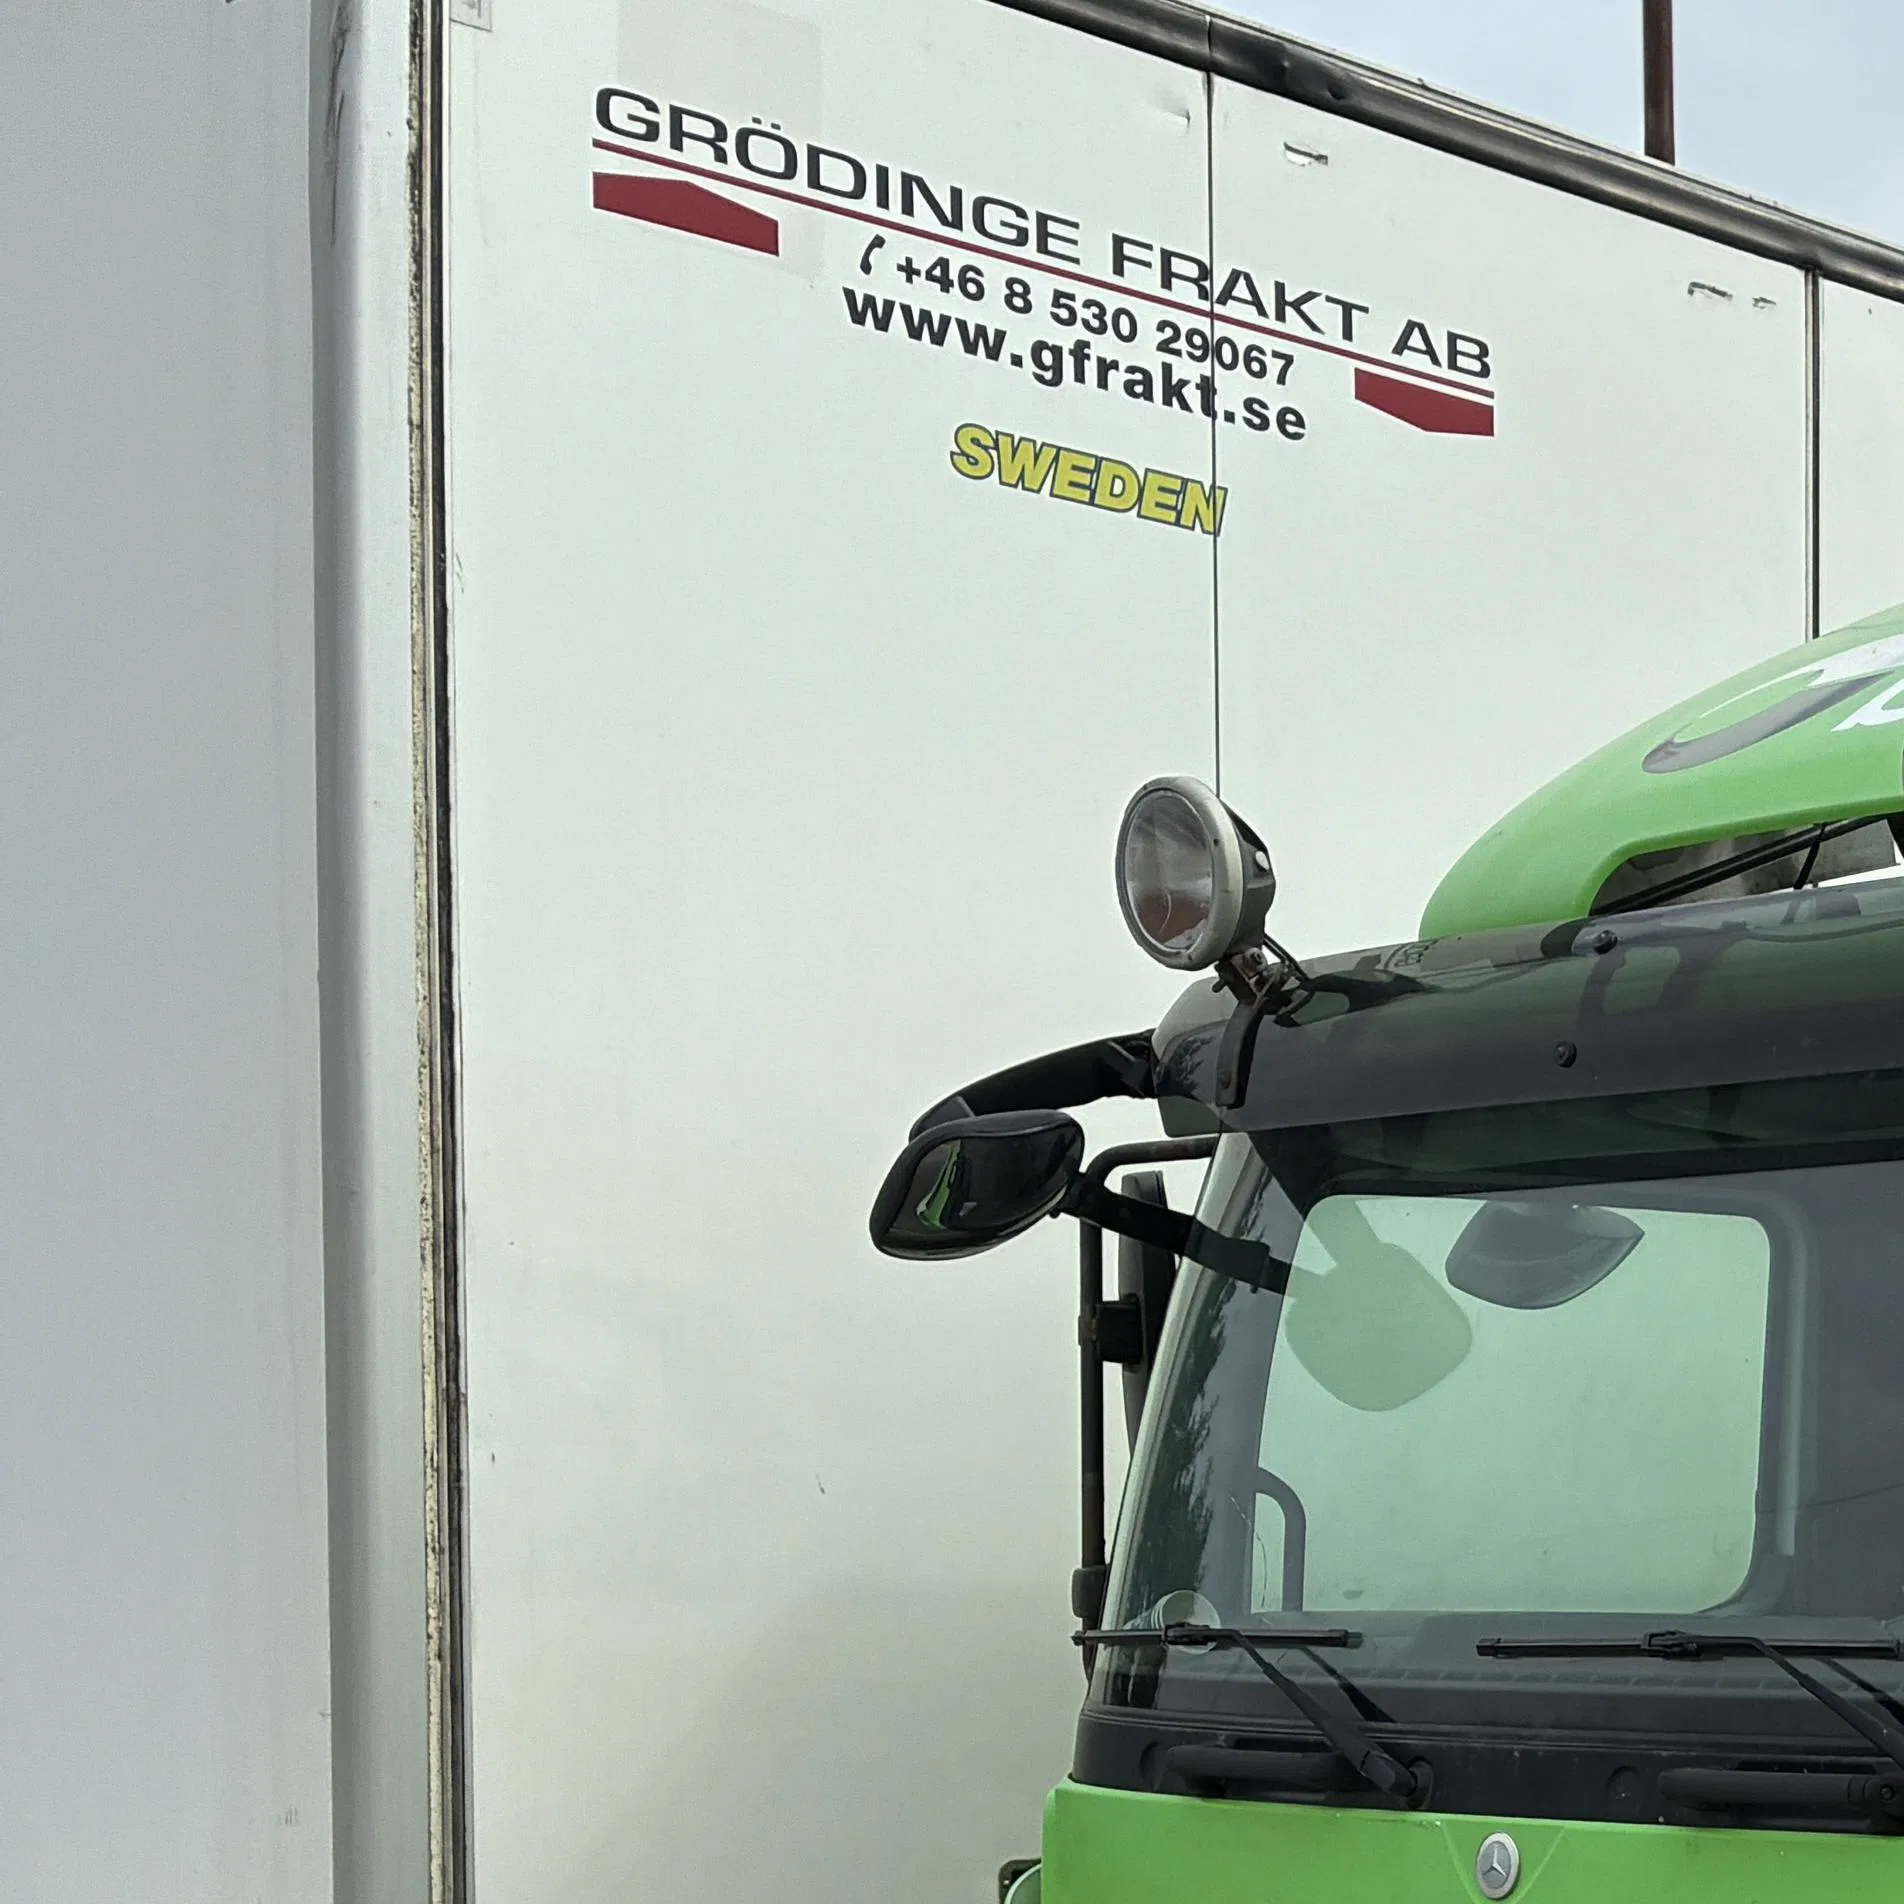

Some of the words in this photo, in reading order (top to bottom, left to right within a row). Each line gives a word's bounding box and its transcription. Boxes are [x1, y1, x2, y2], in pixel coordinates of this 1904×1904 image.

[594, 86, 1081, 266] GRÖDINGE
[1112, 233, 1369, 343] FRAKT
[1392, 319, 1493, 380] AB
[842, 287, 1308, 442] www.gfrakt.se
[895, 256, 985, 303] +46
[1003, 267, 1033, 314] 8
[1050, 291, 1138, 342] 530
[1156, 319, 1295, 386] 29067
[950, 422, 1227, 537] SWEDEN
